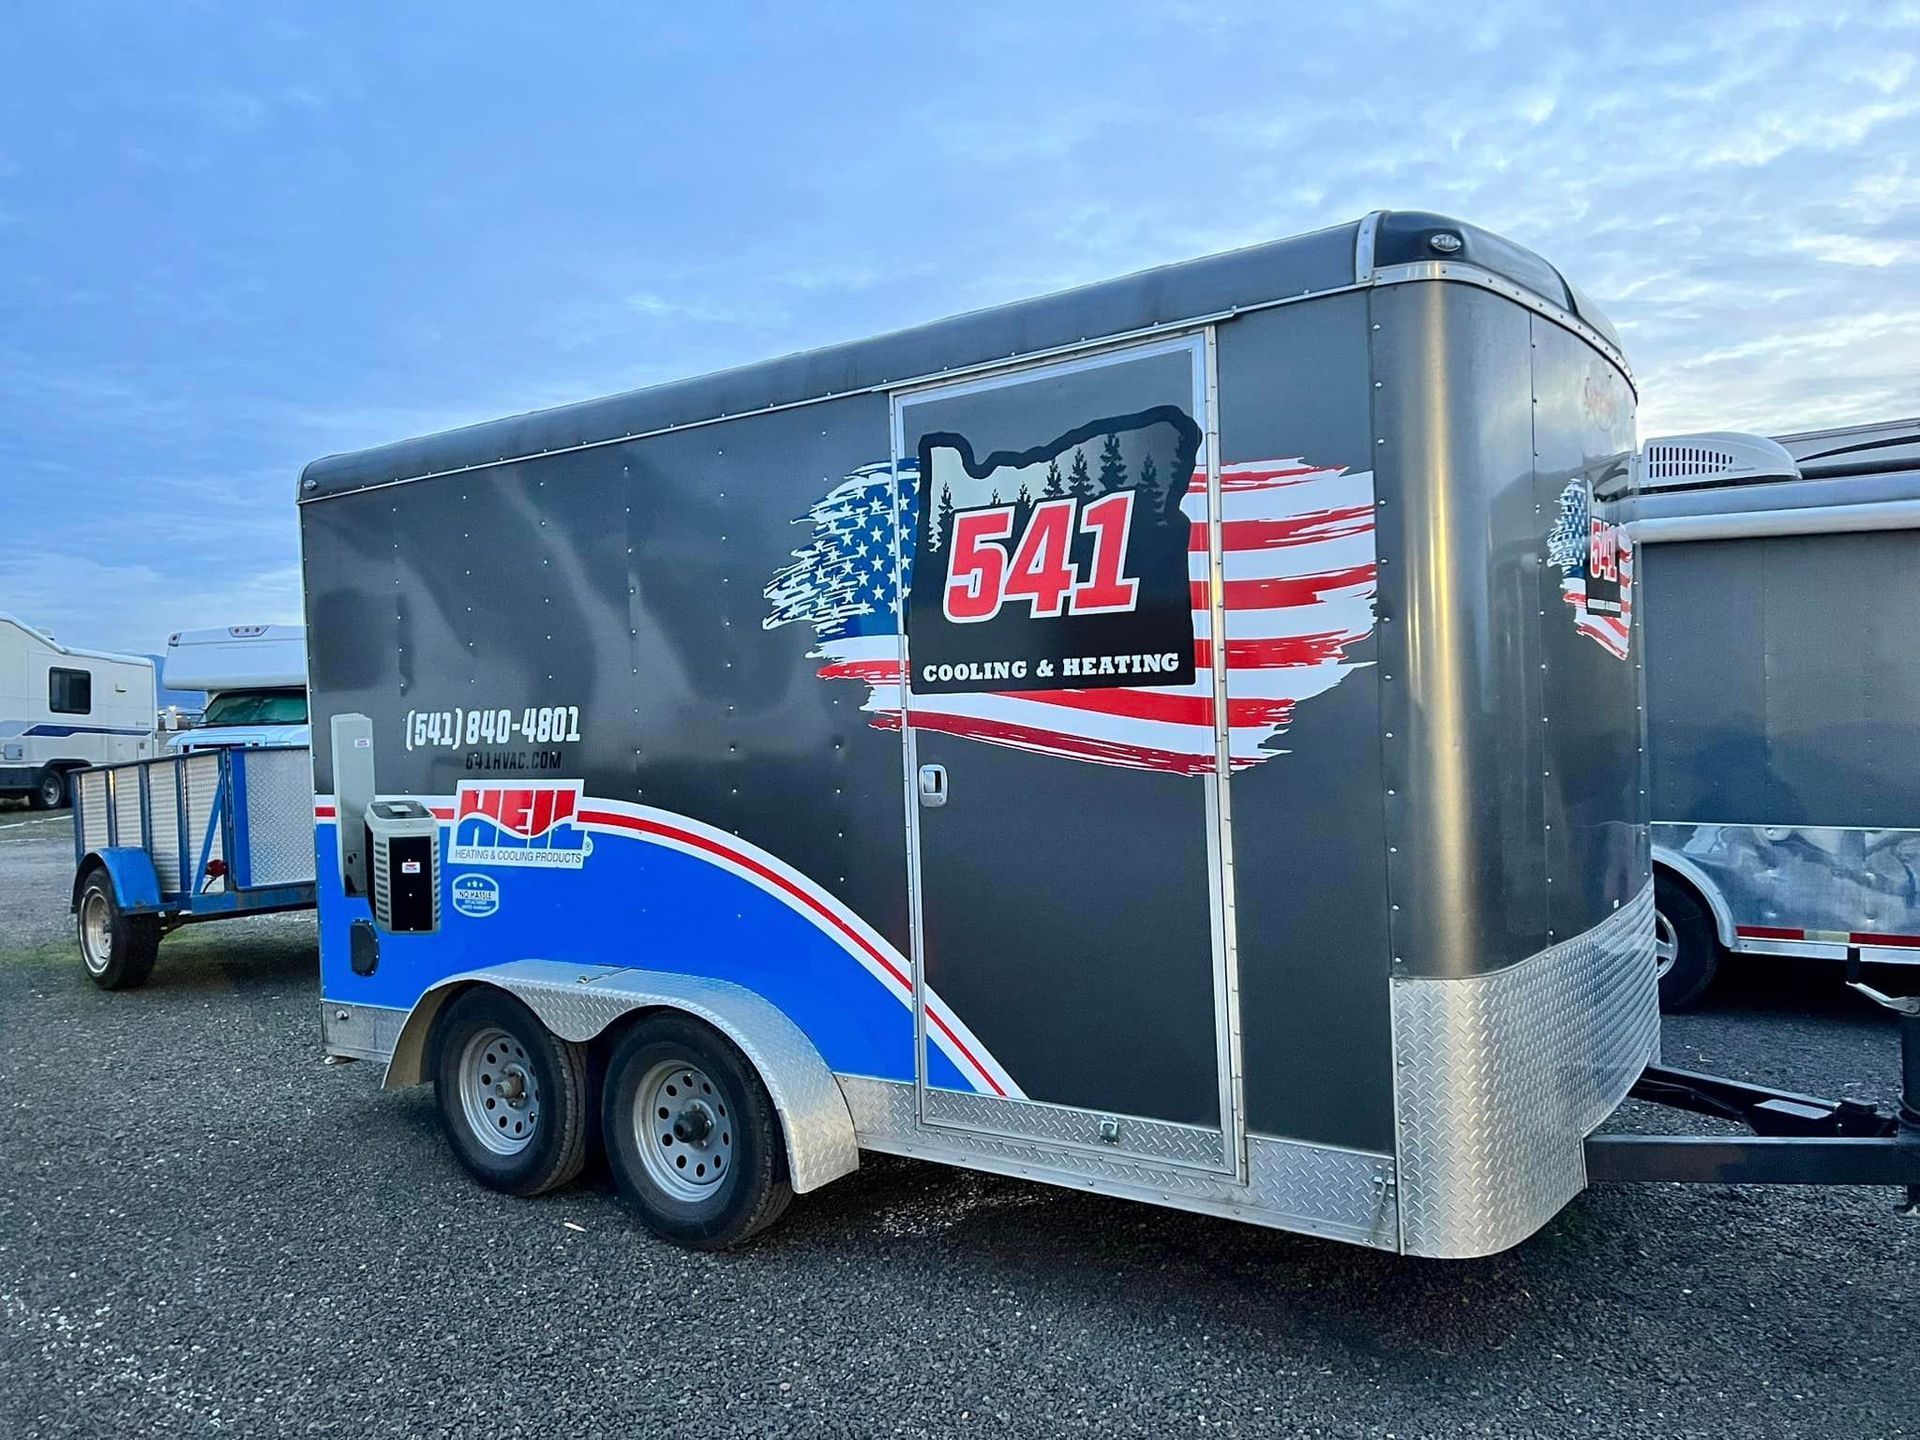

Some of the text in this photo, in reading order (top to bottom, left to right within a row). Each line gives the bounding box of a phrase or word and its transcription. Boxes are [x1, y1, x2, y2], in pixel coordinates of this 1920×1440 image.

[943, 490, 1140, 624] 541
[923, 652, 1179, 682] COOLING & HEATING
[456, 789, 583, 850] HEIL
[455, 849, 582, 864] HEATING & COOLING PRODUCTS
[459, 890, 492, 900] NO HASSLE
